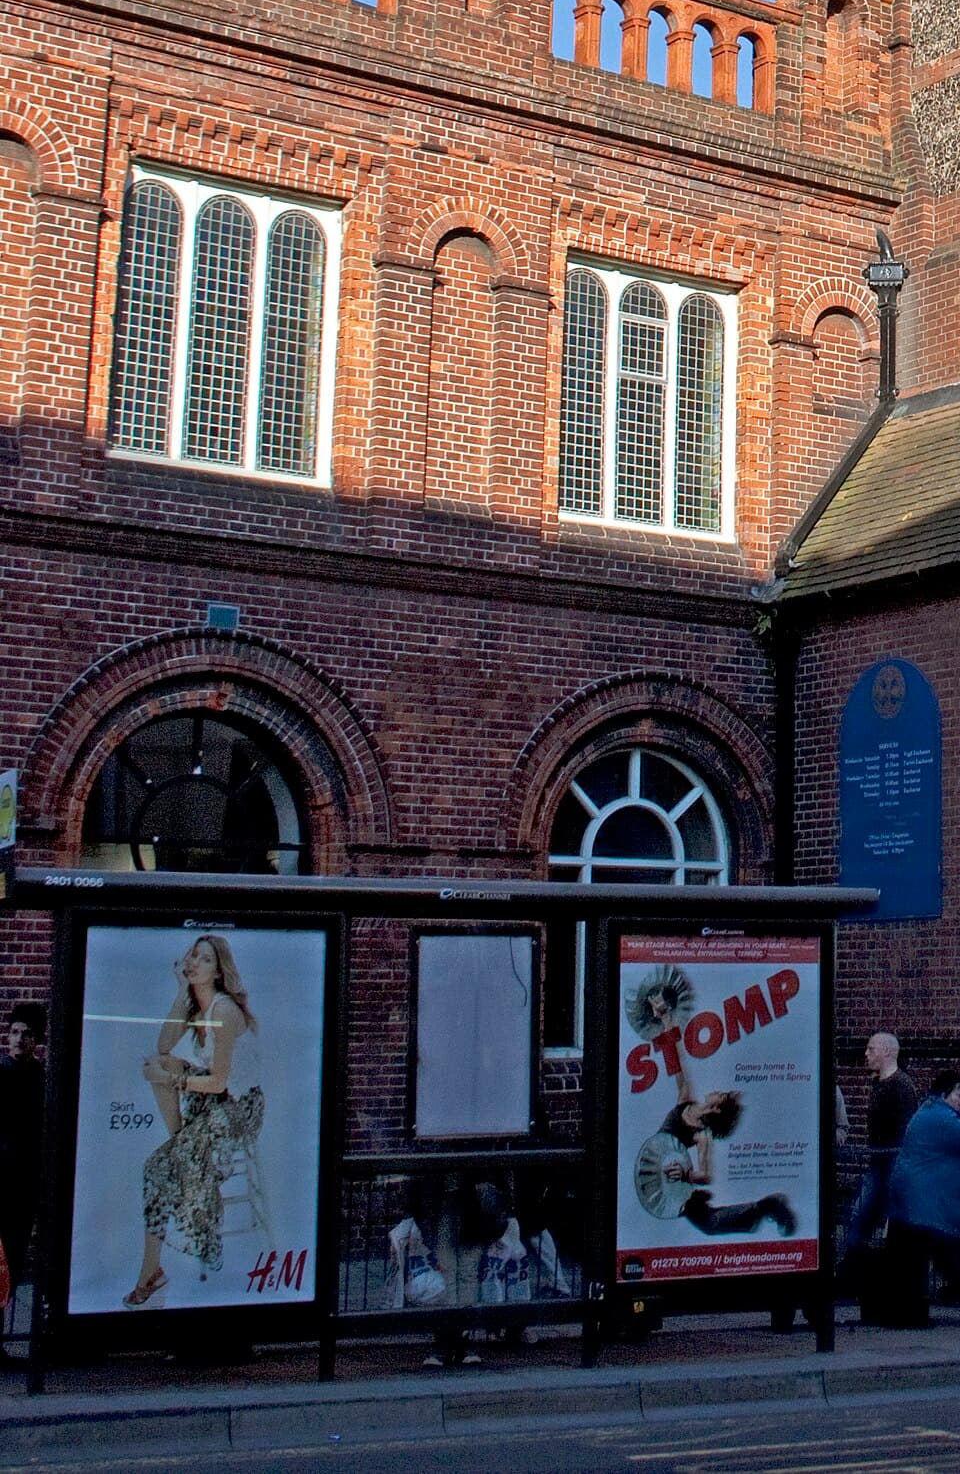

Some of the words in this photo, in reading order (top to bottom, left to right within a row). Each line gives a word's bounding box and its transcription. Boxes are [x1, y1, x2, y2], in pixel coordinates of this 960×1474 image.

[44, 875, 72, 886] 2401
[626, 969, 800, 1093] STOMP
[735, 1062, 762, 1071] Comes
[763, 1062, 786, 1070] home
[786, 1062, 796, 1070] to
[734, 1074, 769, 1083] Brighton
[770, 1073, 785, 1081] this
[786, 1073, 812, 1082] Spring
[109, 1101, 135, 1113] Skirt
[109, 1113, 154, 1130] £9.99
[729, 1143, 742, 1151] Tue
[753, 1142, 767, 1150] Mar
[774, 1141, 788, 1149] Sun
[795, 1141, 809, 1149] Apr
[651, 1257, 679, 1269] 01273
[680, 1255, 713, 1267] 709709
[723, 1252, 803, 1265] brightondome.org
[246, 1249, 308, 1293] H&M
